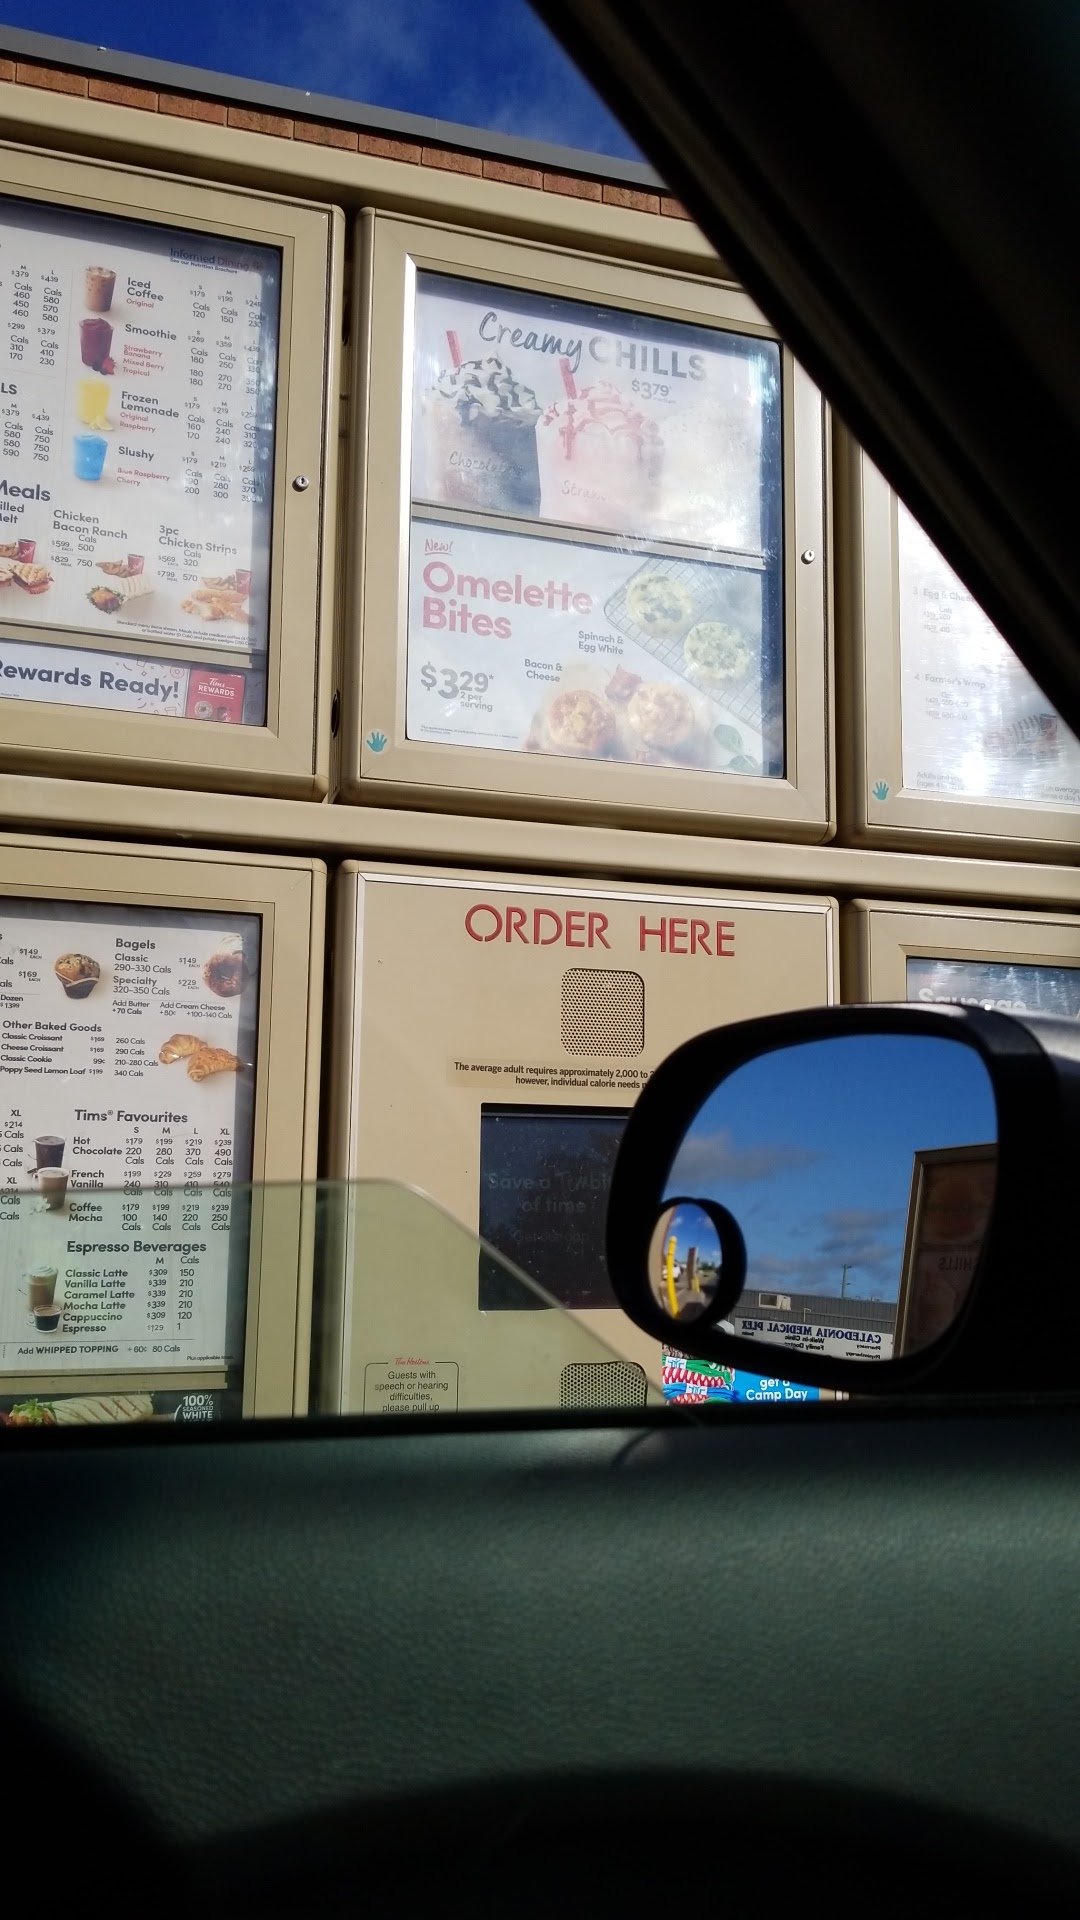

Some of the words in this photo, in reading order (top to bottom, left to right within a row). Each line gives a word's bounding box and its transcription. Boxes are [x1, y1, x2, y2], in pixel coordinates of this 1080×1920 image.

[128, 277, 151, 290] Iced
[127, 286, 164, 302] Coffee
[126, 298, 154, 309] Original
[125, 324, 177, 341] Smoothie
[124, 344, 163, 358] Strawberry
[480, 311, 583, 374] Creamy
[589, 336, 706, 382] CHILLS
[124, 350, 151, 360] Banana
[123, 358, 144, 368] Mixed
[146, 360, 164, 372] Berry
[122, 366, 150, 378] Tropical
[122, 390, 160, 405] Frozen
[121, 400, 180, 418] Lemonade
[120, 412, 148, 422] Original
[120, 420, 156, 434] Raspberry
[118, 446, 154, 462] Slushy
[116, 476, 140, 487] Cherry
[134, 470, 170, 482] Raspberry
[54, 509, 100, 524] Chicken
[53, 520, 89, 534] Bacon
[92, 525, 128, 540] Ranch
[158, 525, 179, 537] 3pc
[52, 540, 70, 548] $599
[78, 544, 94, 552] 500
[158, 536, 203, 550] Chicken
[206, 540, 238, 556] Strips
[425, 538, 454, 552] New!
[76, 558, 92, 568] 750
[422, 560, 594, 616] Omelette
[422, 596, 512, 640] Bites
[578, 630, 614, 645] Spinach
[616, 636, 624, 645] &
[578, 642, 596, 654] Egg
[598, 644, 624, 656] White
[525, 658, 554, 671] Bacon
[556, 662, 562, 672] &
[0, 660, 92, 687] ewards
[100, 671, 179, 702] Ready!
[526, 670, 561, 683] Cheese
[198, 685, 235, 697] REWARDS
[467, 694, 482, 704] per
[460, 700, 493, 714] serving
[465, 904, 612, 950] ORDER
[640, 916, 735, 957] HERE
[116, 938, 156, 952] Bagels
[114, 952, 149, 963] Classic
[179, 956, 196, 964] $149
[153, 964, 172, 974] Cals
[114, 975, 157, 986] Specialty
[152, 986, 170, 996] Cals
[0, 994, 24, 1002] Dozen
[112, 1000, 126, 1008] Add
[128, 1000, 150, 1008] Butter
[175, 1002, 198, 1010] Cream
[200, 1004, 226, 1012] Cheese
[218, 1011, 232, 1019] Cals
[2, 1020, 32, 1030] Other
[35, 1022, 67, 1032] Baked
[70, 1022, 102, 1032] Goods
[2, 1032, 28, 1040] Classic
[2, 1044, 28, 1052] Cheese
[0, 1054, 26, 1062] Classic
[0, 1066, 22, 1075] Poppy
[24, 1066, 42, 1074] Seed
[43, 1067, 68, 1075] Lemon
[70, 1068, 86, 1076] Loaf
[454, 1062, 470, 1072] The
[470, 1064, 502, 1077] average
[504, 1064, 525, 1074] adult
[526, 1065, 558, 1078] requires
[559, 1066, 614, 1080] approximately
[615, 1068, 638, 1080] 2,000
[640, 1070, 648, 1079] to
[516, 1076, 550, 1086] however,
[551, 1077, 588, 1088] individual
[590, 1078, 616, 1088] calorie
[617, 1079, 640, 1089] needs
[117, 1110, 188, 1123] Favourites
[74, 1137, 90, 1145] Hot
[72, 1147, 122, 1156] Chocolate
[72, 1170, 104, 1178] French
[70, 1180, 104, 1188] Vanilla
[70, 1204, 102, 1212] Coffee
[68, 1214, 103, 1222] Mocha
[67, 1240, 130, 1256] Espresso
[134, 1241, 206, 1255] Beverages
[66, 1268, 100, 1278] Classic
[103, 1269, 128, 1278] Latte
[180, 1269, 194, 1277] 150
[64, 1280, 98, 1288] Vanilla
[100, 1280, 126, 1288] Latte
[64, 1290, 108, 1300] Caramel
[110, 1290, 135, 1299] Latte
[178, 1290, 193, 1298] 210
[64, 1302, 98, 1310] Mocha
[101, 1302, 126, 1310] Latte
[178, 1301, 192, 1309] 210
[62, 1312, 122, 1324] Cappuccino
[62, 1324, 106, 1334] Espresso
[18, 1347, 34, 1355] Add
[36, 1346, 77, 1354] WHIPPED
[164, 1345, 180, 1353] Cals
[388, 1372, 418, 1380] Guests
[420, 1371, 436, 1379] with
[374, 1382, 404, 1392] speech
[418, 1382, 448, 1392] hearing
[760, 1380, 778, 1391] get
[182, 1394, 214, 1406] 100%
[390, 1392, 433, 1402] difficulties,
[746, 1388, 782, 1401] Camp
[784, 1388, 808, 1401] Day
[382, 1403, 410, 1414] please
[412, 1403, 427, 1412] pull
[430, 1404, 440, 1412] up
[182, 1410, 214, 1420] WHITE
